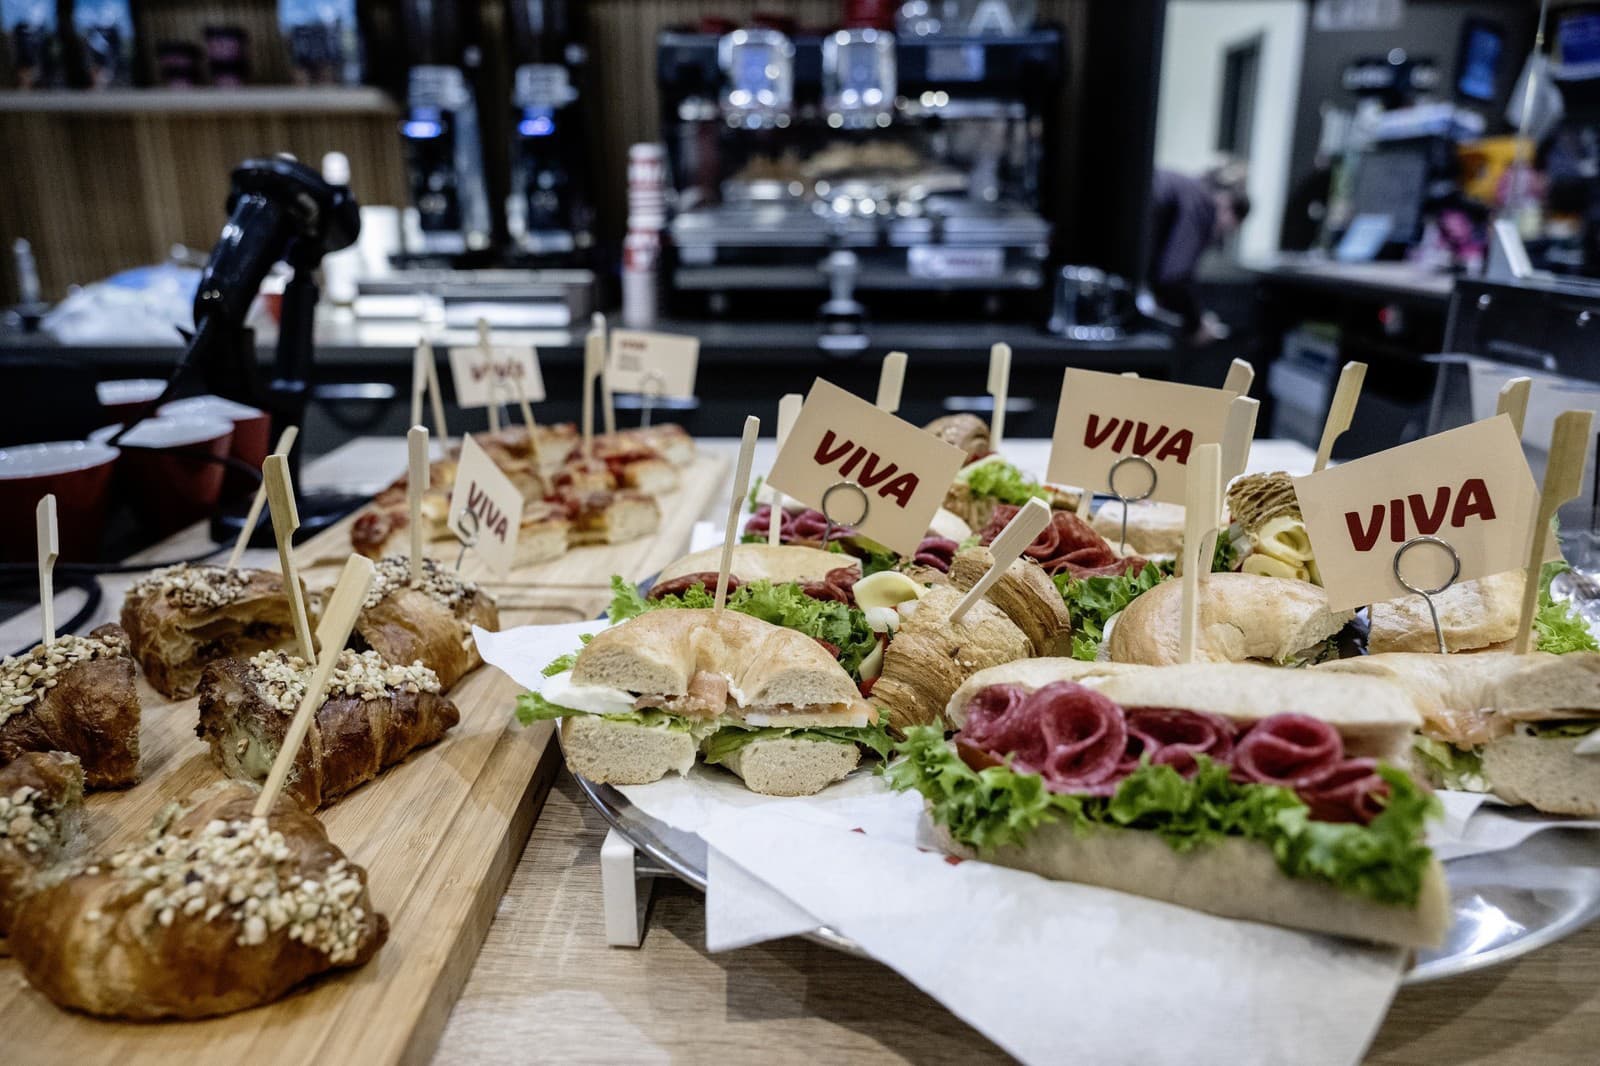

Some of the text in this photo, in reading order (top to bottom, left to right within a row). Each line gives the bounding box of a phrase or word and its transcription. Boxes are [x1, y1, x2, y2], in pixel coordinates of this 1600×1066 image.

[814, 431, 920, 509] VIVA
[1084, 414, 1194, 465] VIVA
[467, 480, 509, 545] VIVA
[1344, 478, 1496, 552] VIVA
